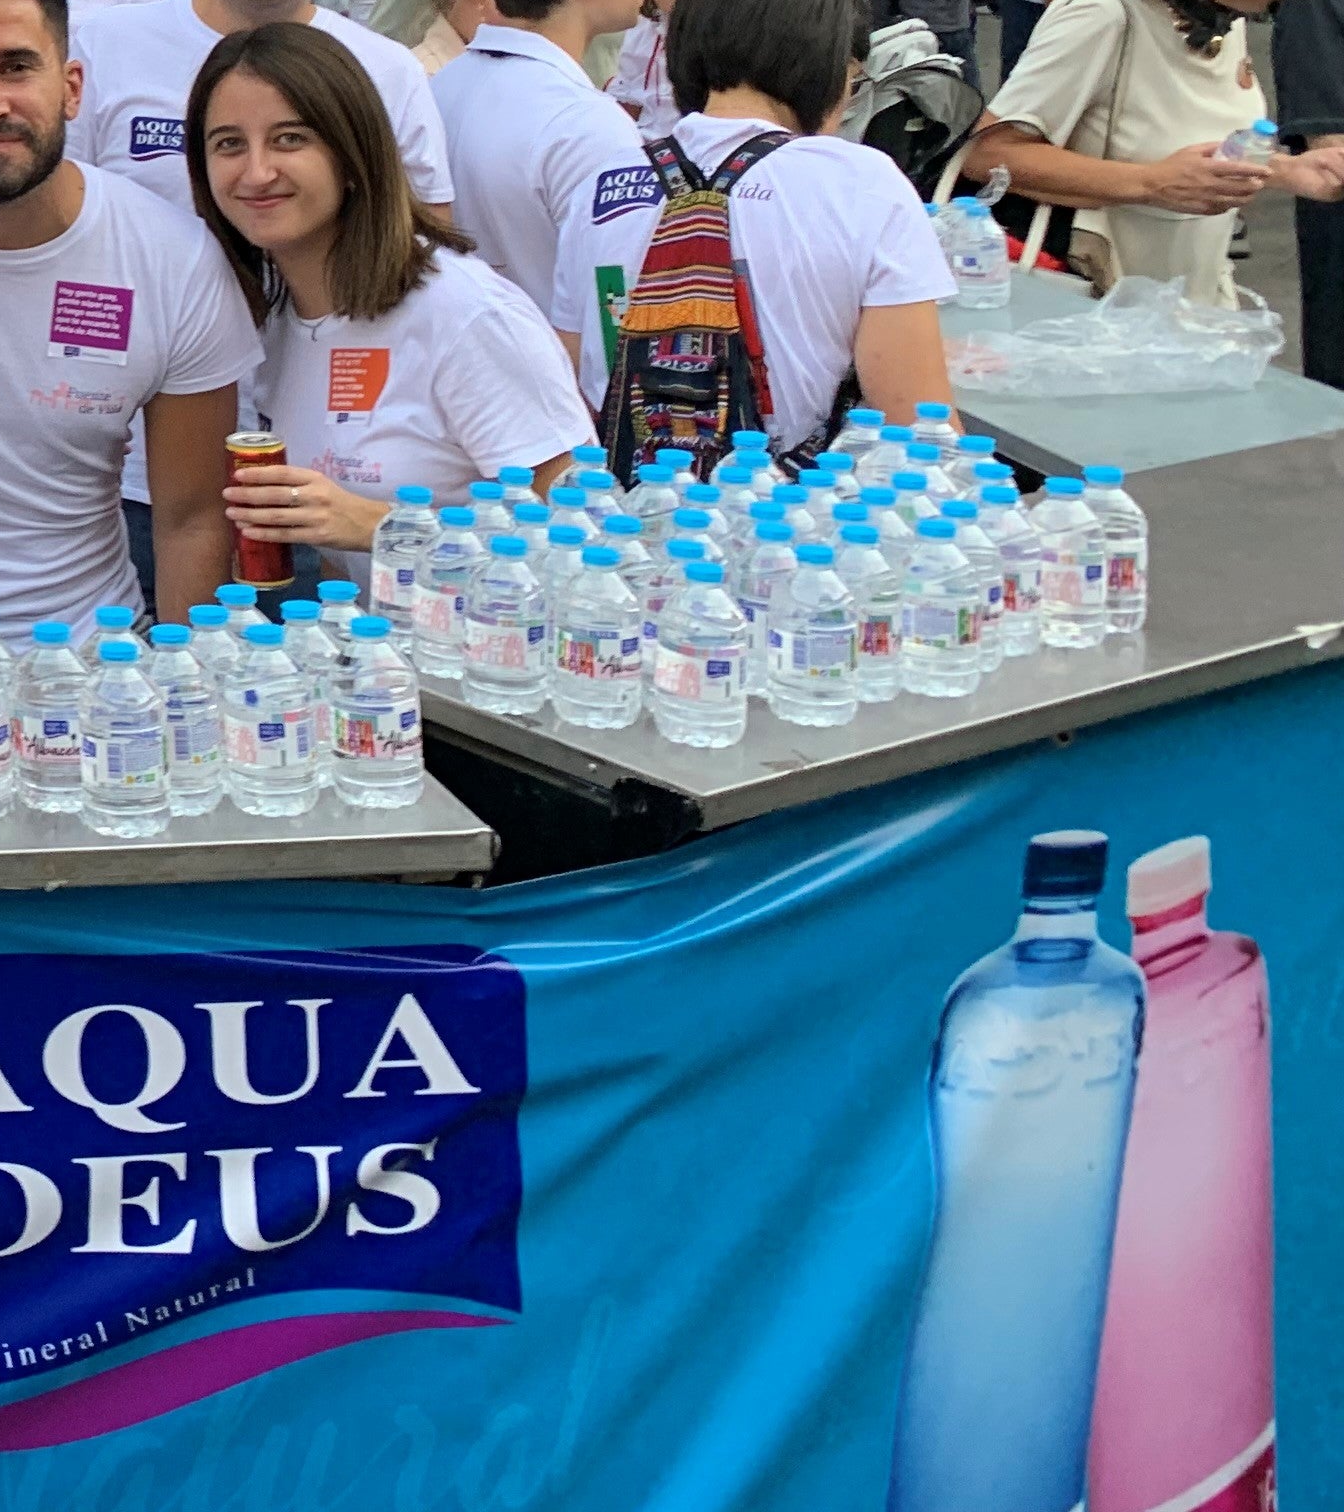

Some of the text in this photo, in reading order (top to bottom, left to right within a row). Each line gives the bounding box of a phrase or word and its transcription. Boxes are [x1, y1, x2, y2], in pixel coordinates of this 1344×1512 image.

[134, 120, 186, 134] AQUA
[136, 133, 183, 147] DEUS
[600, 170, 661, 190] AQUA
[598, 184, 655, 205] DEUS
[736, 182, 774, 201] ida
[123, 1266, 257, 1333] Natural
